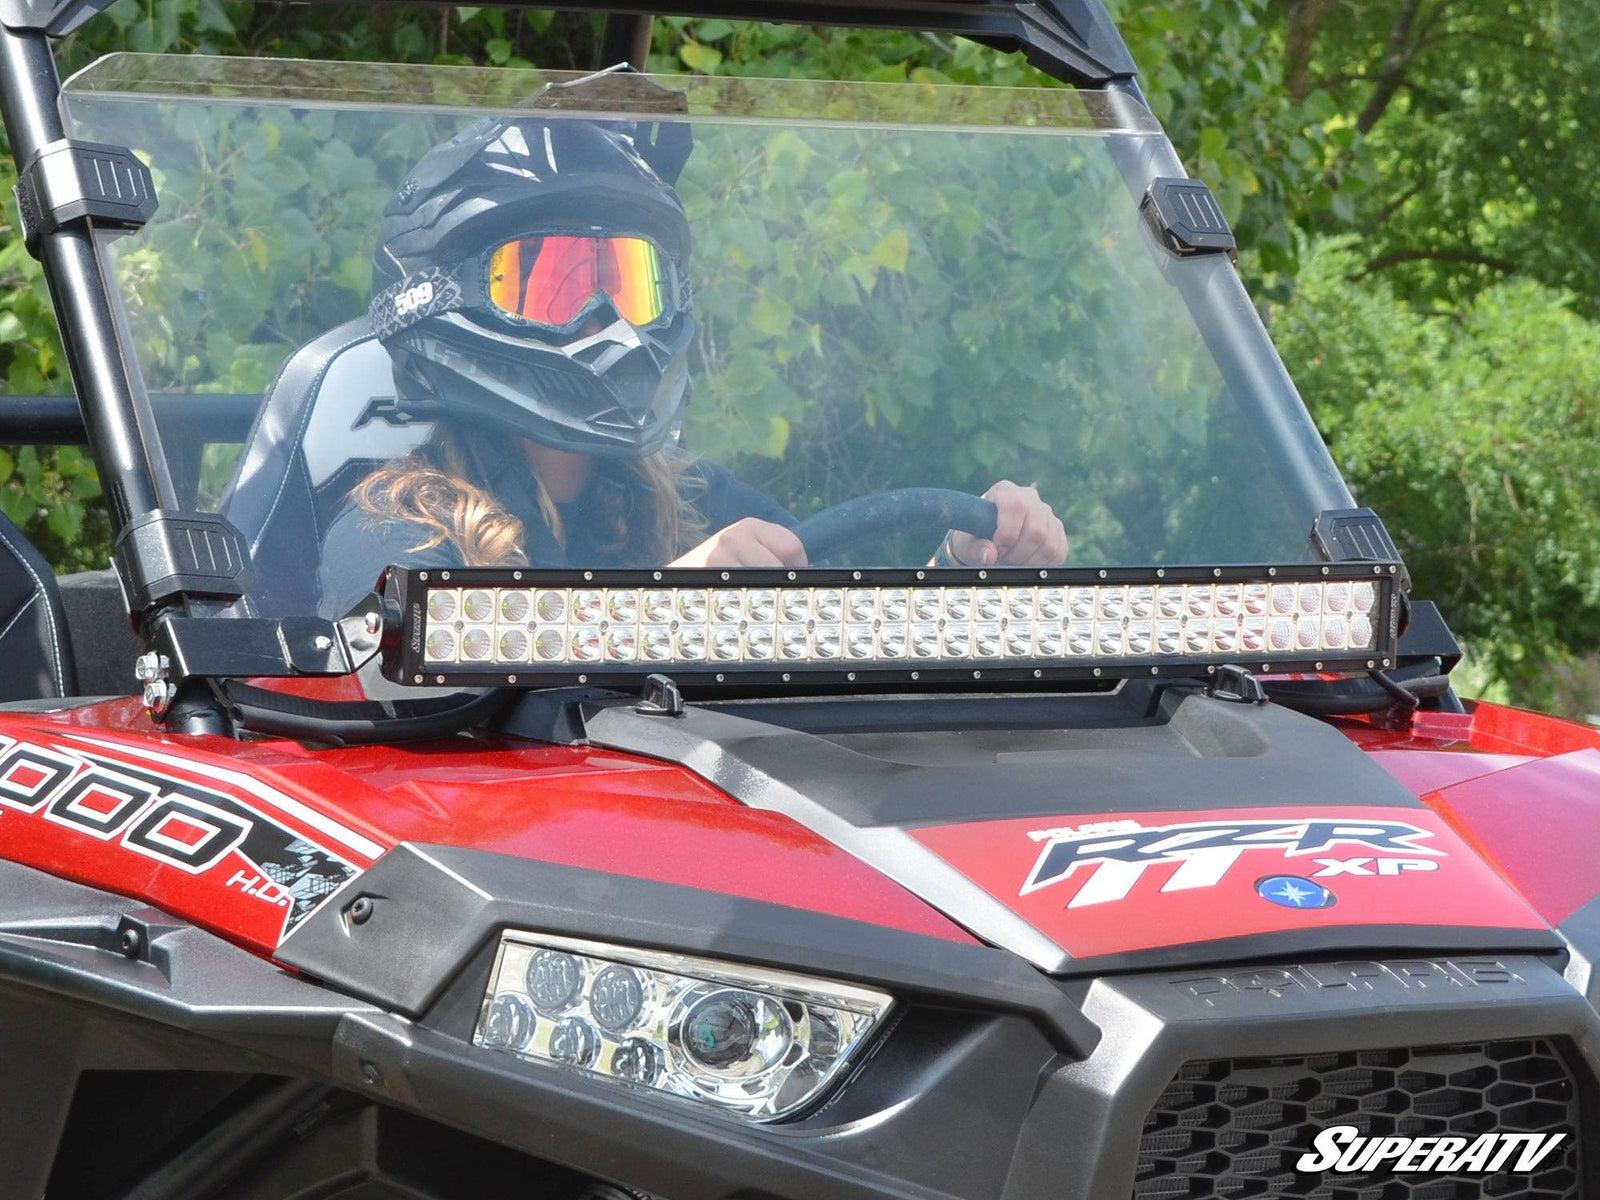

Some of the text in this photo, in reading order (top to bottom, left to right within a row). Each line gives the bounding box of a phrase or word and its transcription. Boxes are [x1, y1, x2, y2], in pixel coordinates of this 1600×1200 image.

[395, 281, 434, 316] 509
[0, 734, 255, 875] 000
[1018, 817, 1448, 897] RZR
[1311, 857, 1441, 877] XP
